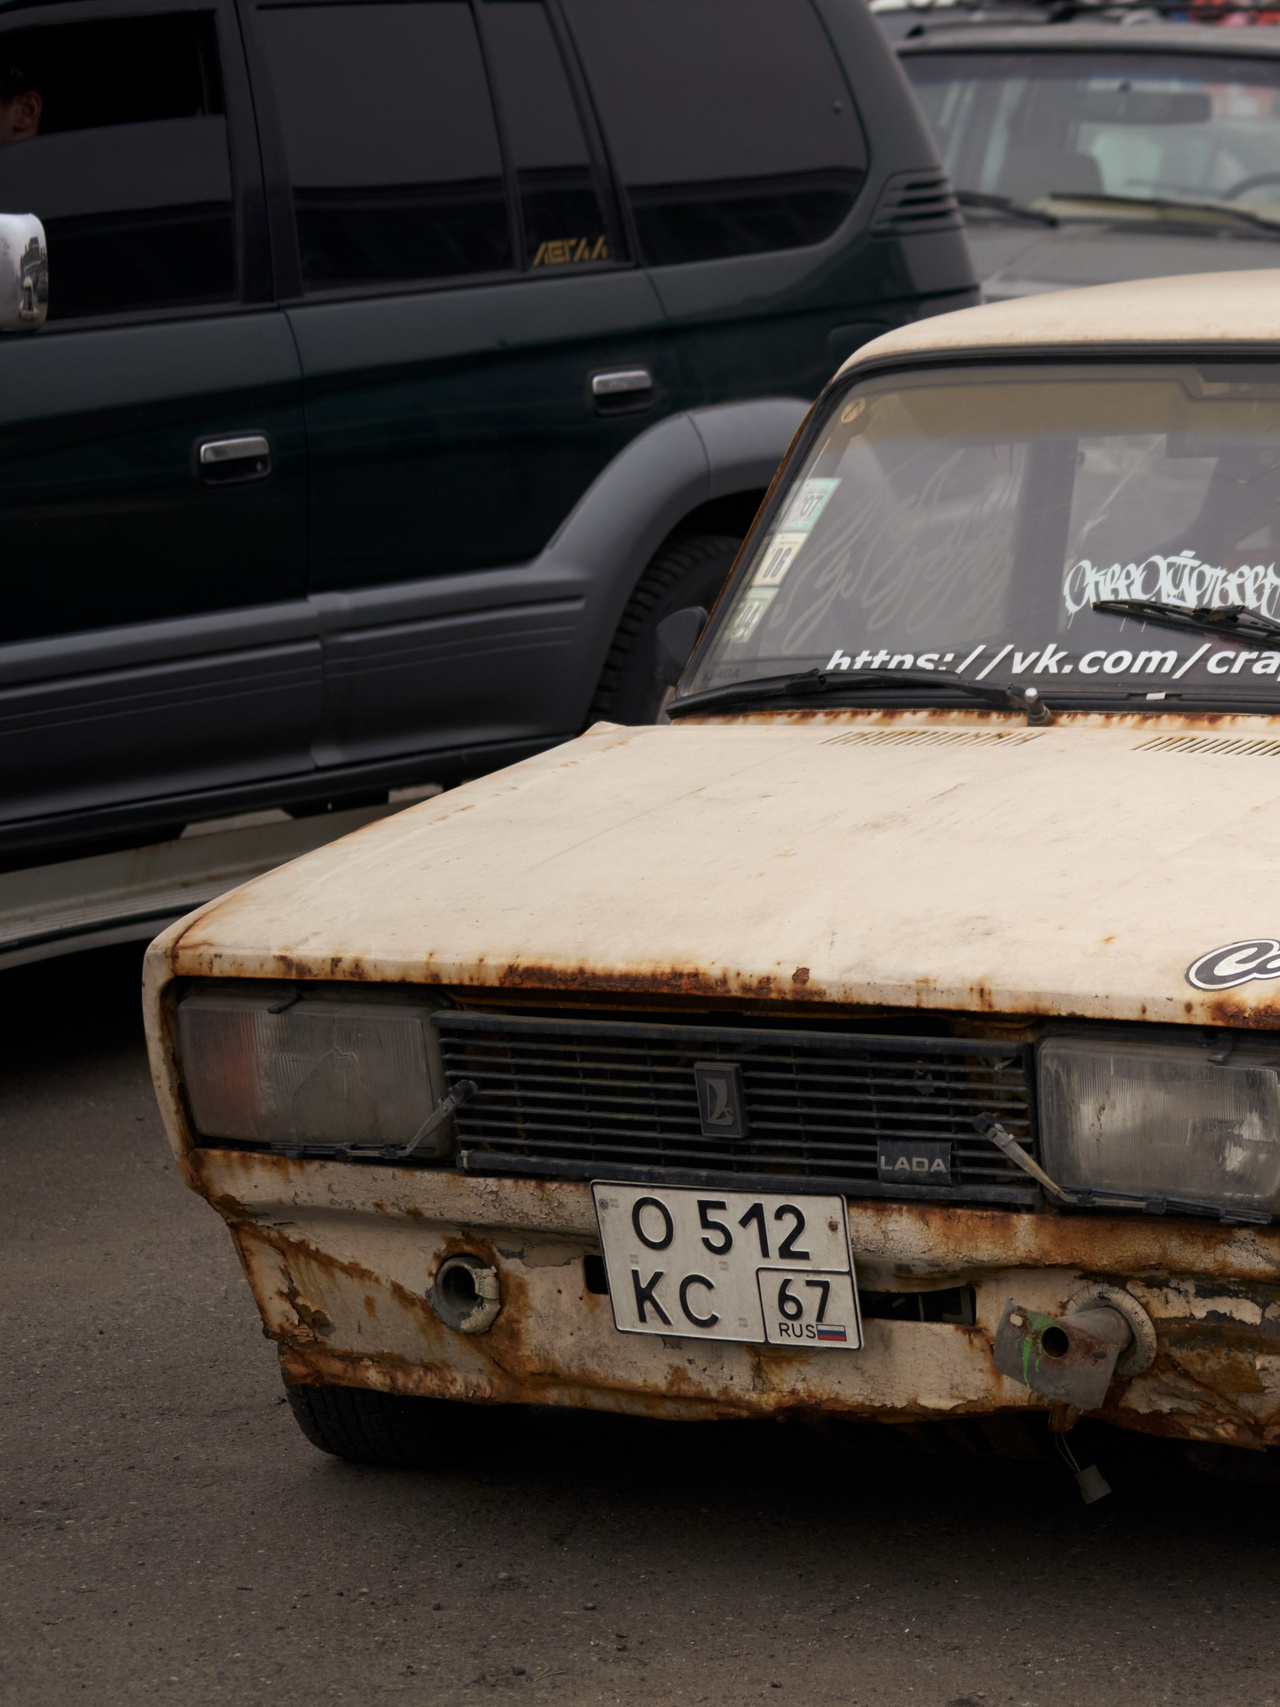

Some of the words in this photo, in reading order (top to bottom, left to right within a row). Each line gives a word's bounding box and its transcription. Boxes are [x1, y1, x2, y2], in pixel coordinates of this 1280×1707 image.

[880, 1155, 947, 1173] LADA
[697, 1199, 810, 1260] 512
[777, 1278, 831, 1322] 67
[779, 1323, 816, 1338] RUS
